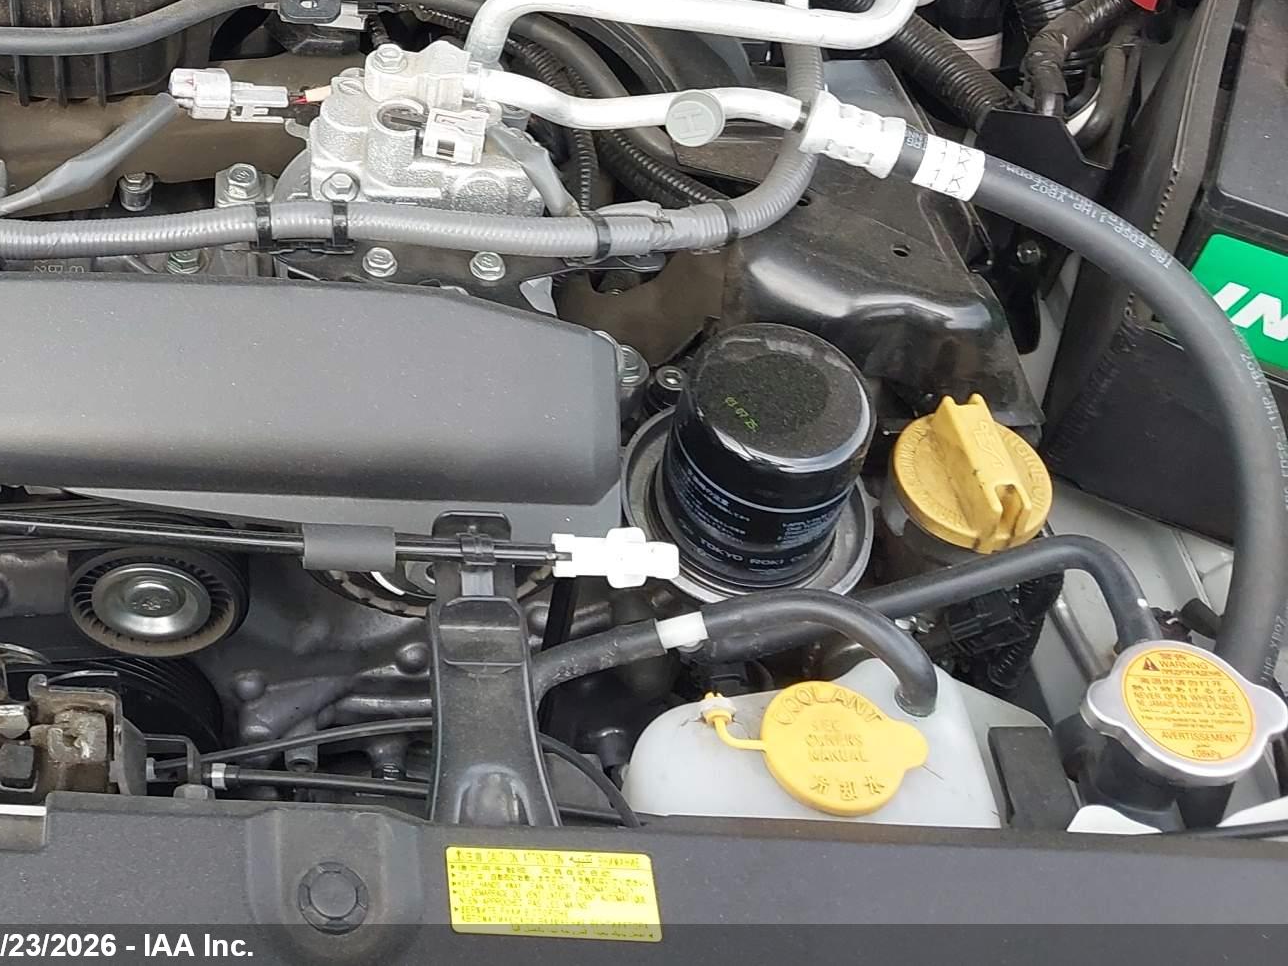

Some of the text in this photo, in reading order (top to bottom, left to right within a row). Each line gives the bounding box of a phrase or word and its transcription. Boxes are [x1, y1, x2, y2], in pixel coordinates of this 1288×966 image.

[699, 537, 743, 562] TOKYO
[750, 558, 785, 566] ROKI
[1158, 660, 1209, 670] WARNING
[1165, 693, 1187, 701] OPEN
[1191, 694, 1216, 702] WHEN
[774, 685, 884, 726] COOLANT
[1161, 731, 1239, 743] AVERTISSEMENT
